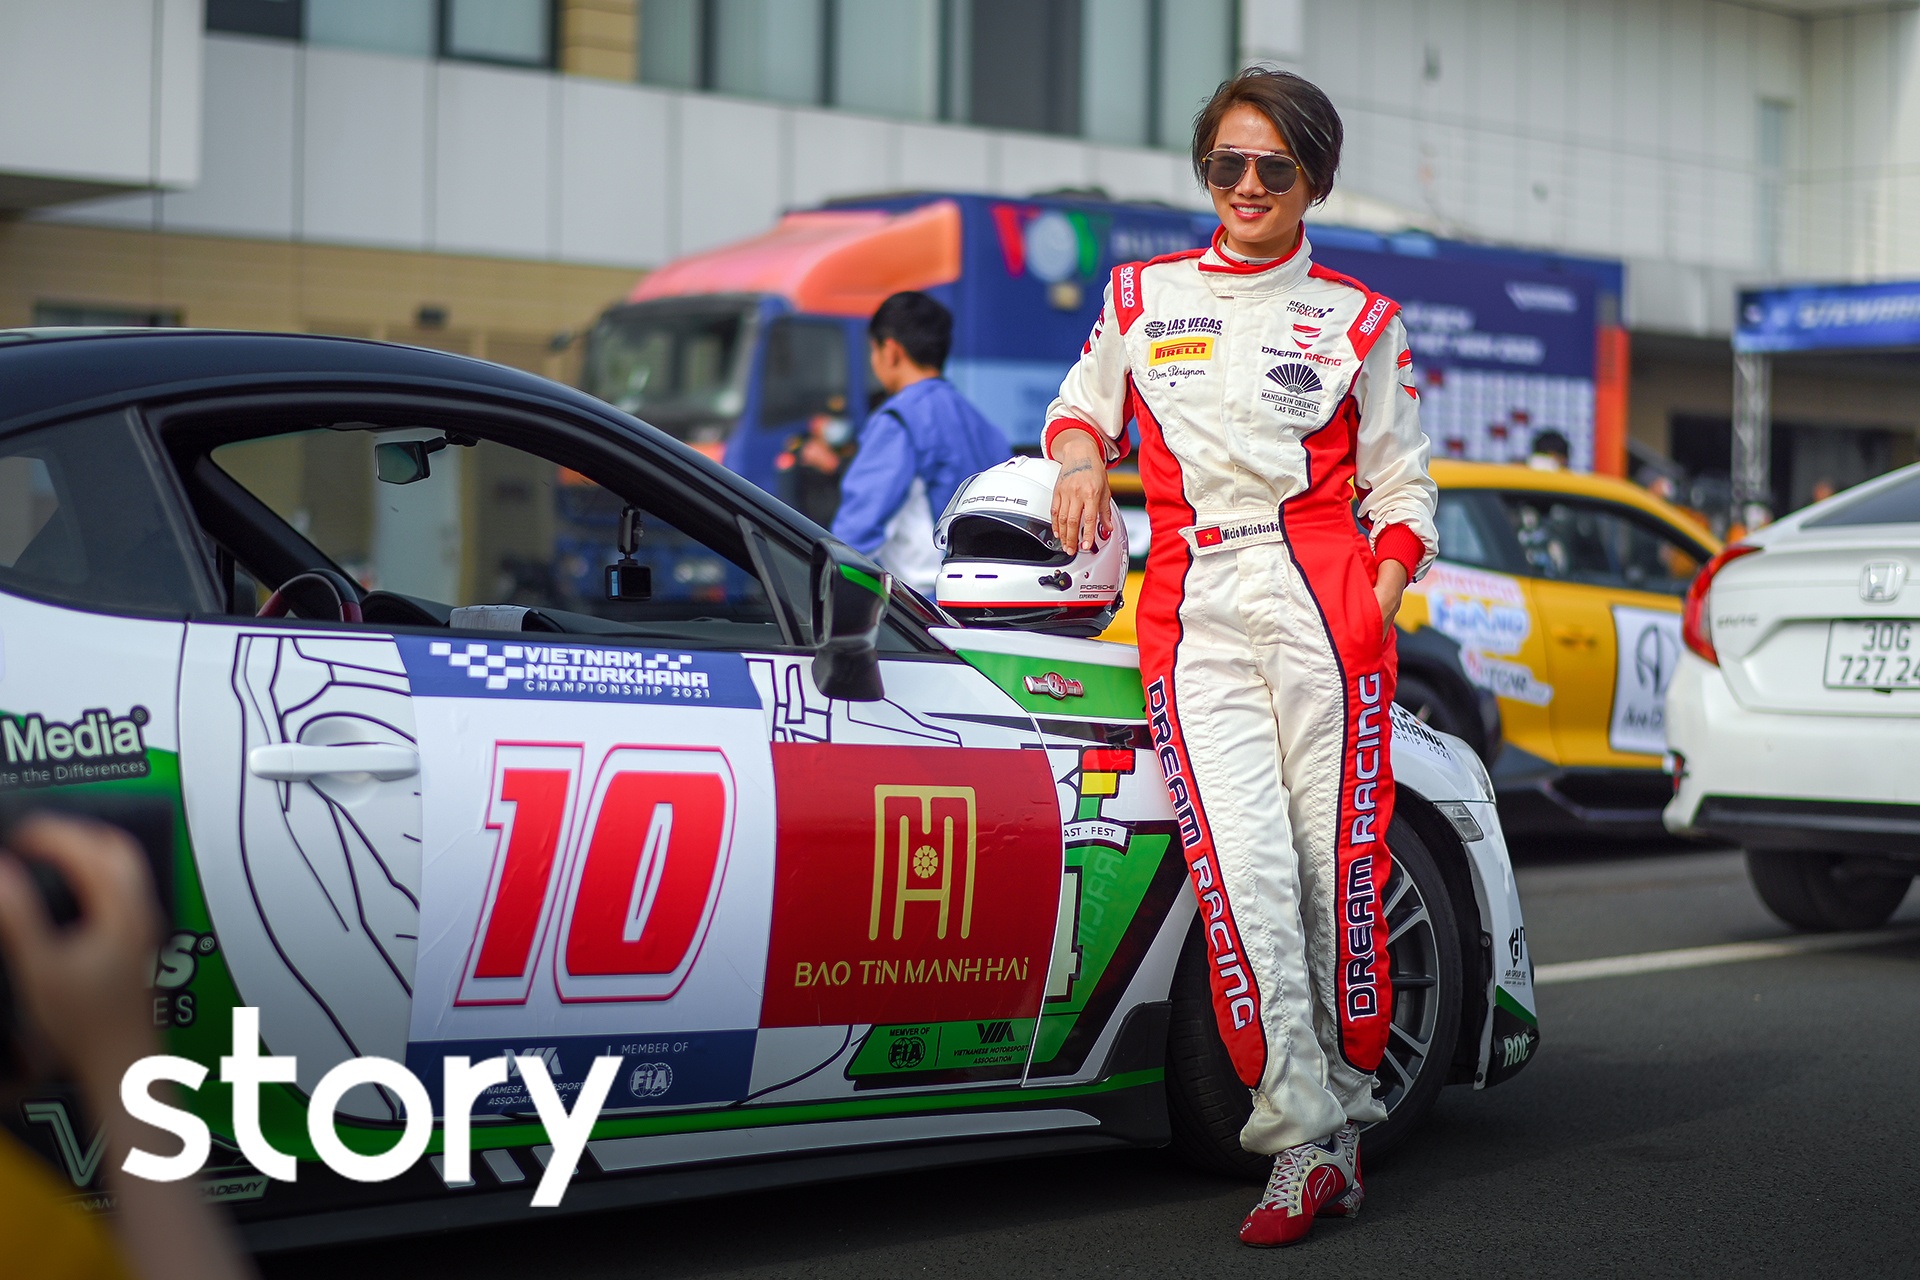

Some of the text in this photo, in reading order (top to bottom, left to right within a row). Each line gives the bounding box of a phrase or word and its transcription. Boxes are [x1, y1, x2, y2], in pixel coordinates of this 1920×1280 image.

[1120, 266, 1135, 308] sparco
[1289, 300, 1318, 313] READY
[1167, 317, 1223, 331] LAS VEGAS
[1359, 299, 1388, 335] sparco
[1155, 342, 1207, 359] PIRELLI
[1261, 346, 1302, 359] DREAM
[1148, 369, 1167, 381] Dom
[1261, 392, 1319, 412] MANDARIN ORIENTAL
[1274, 405, 1306, 418] LAS VEGAS
[962, 495, 1028, 507] PORSCHE
[1863, 623, 1911, 651] 30G
[524, 646, 643, 669] VIETNAM
[524, 663, 710, 688] MOTORKHANA
[523, 680, 711, 699] CHAMPIONSHIP 2021
[1426, 742, 1452, 761] 2021
[1147, 675, 1203, 849] DREAM
[22, 766, 50, 783] the
[54, 761, 147, 781] Differences
[1091, 826, 1117, 838] FEST
[468, 762, 731, 982] 10
[1346, 855, 1379, 1023] DREAM
[794, 961, 851, 987] BAO
[920, 1026, 930, 1035] OF
[621, 1042, 689, 1055] MEMBER OF
[953, 1047, 989, 1057] VIETNAMESE
[973, 1055, 1013, 1065] ASSOCIATION
